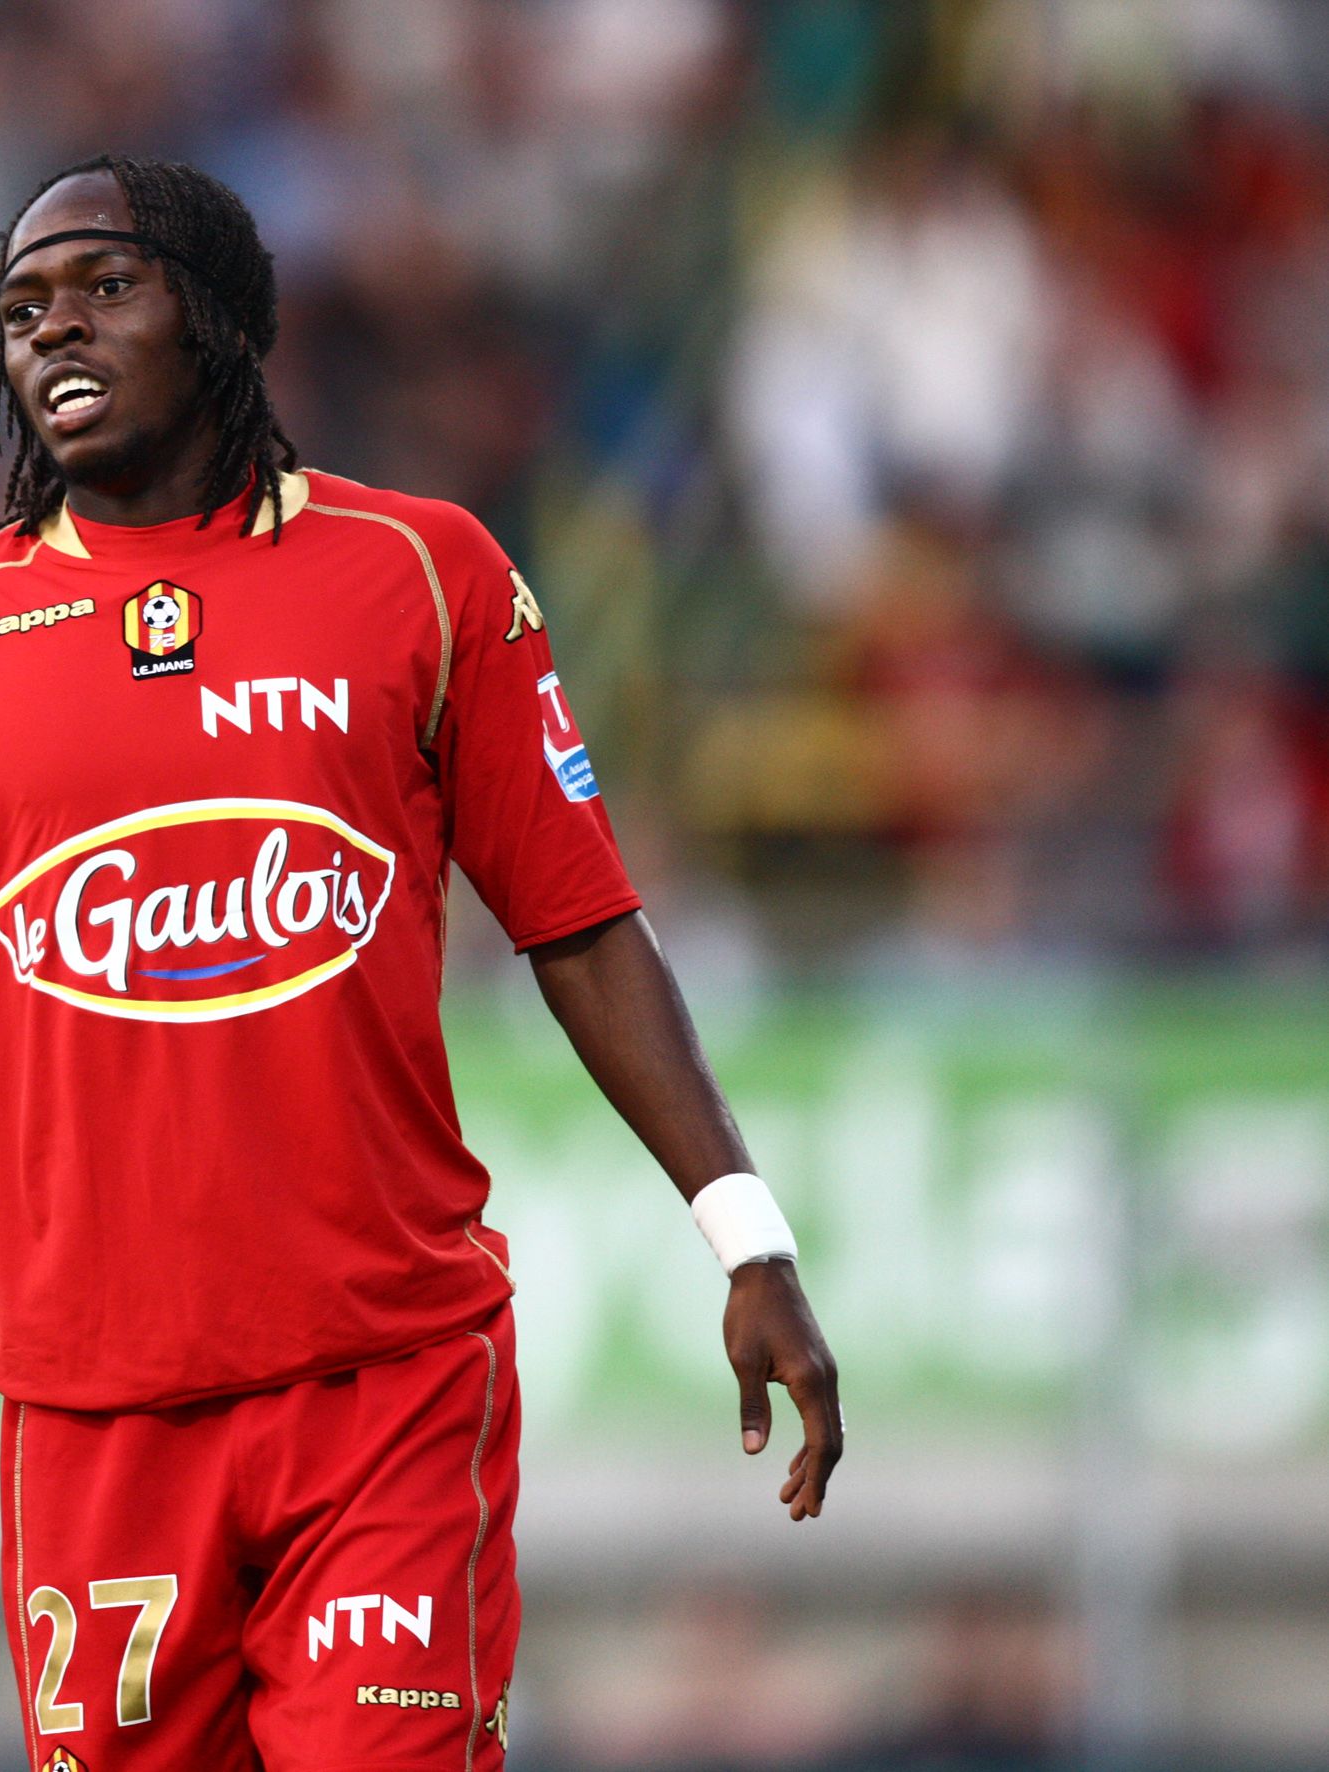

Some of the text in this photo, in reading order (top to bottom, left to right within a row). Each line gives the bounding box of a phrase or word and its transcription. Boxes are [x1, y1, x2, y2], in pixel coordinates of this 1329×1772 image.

[149, 632, 176, 649] 72
[200, 677, 349, 738] NTN
[13, 827, 368, 992] le Gaulois
[27, 1574, 178, 1735] 27
[308, 1594, 433, 1662] NTN
[356, 1684, 461, 1710] Kappa
